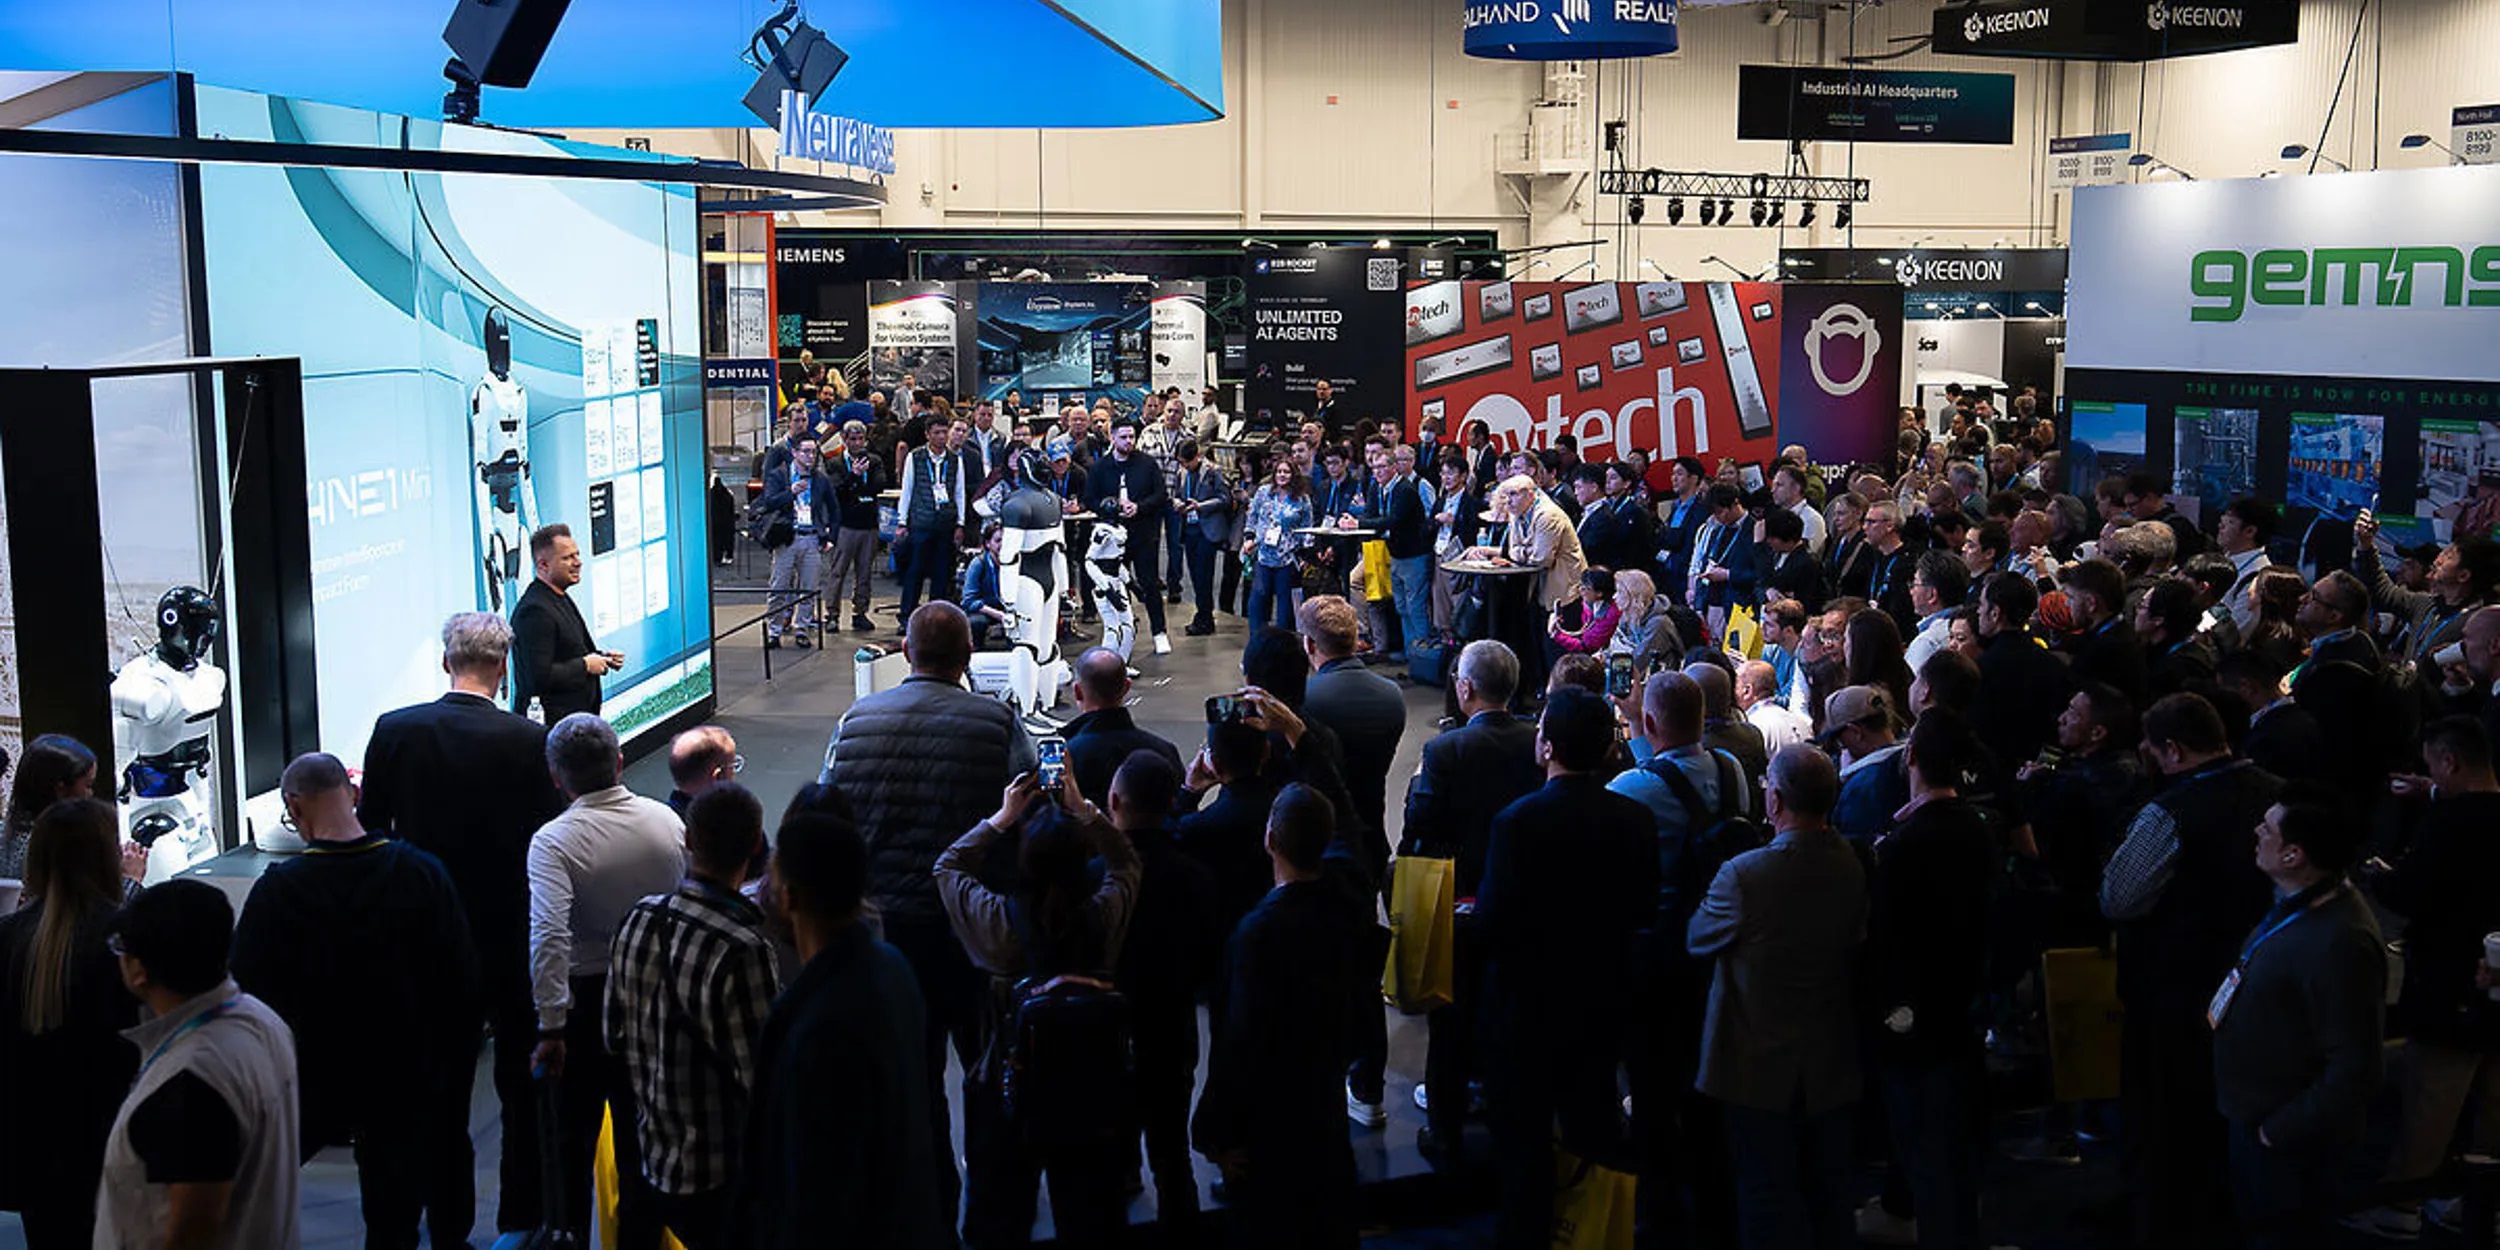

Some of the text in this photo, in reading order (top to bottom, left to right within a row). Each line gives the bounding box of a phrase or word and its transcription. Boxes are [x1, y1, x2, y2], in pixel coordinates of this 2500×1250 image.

[1986, 8, 2049, 34] KEENON
[2172, 5, 2242, 28] KEENON
[1802, 81, 1959, 101] Industrial AI Headquarters
[776, 247, 845, 263] IEMENS
[1924, 260, 2003, 281] KEENON
[1255, 310, 1343, 325] UNLIMITED
[889, 333, 917, 343] Vision
[918, 333, 951, 344] System
[1256, 326, 1339, 341] AI AGENTS
[2184, 381, 2500, 406] THE TIME IS NOW FOR ENERG
